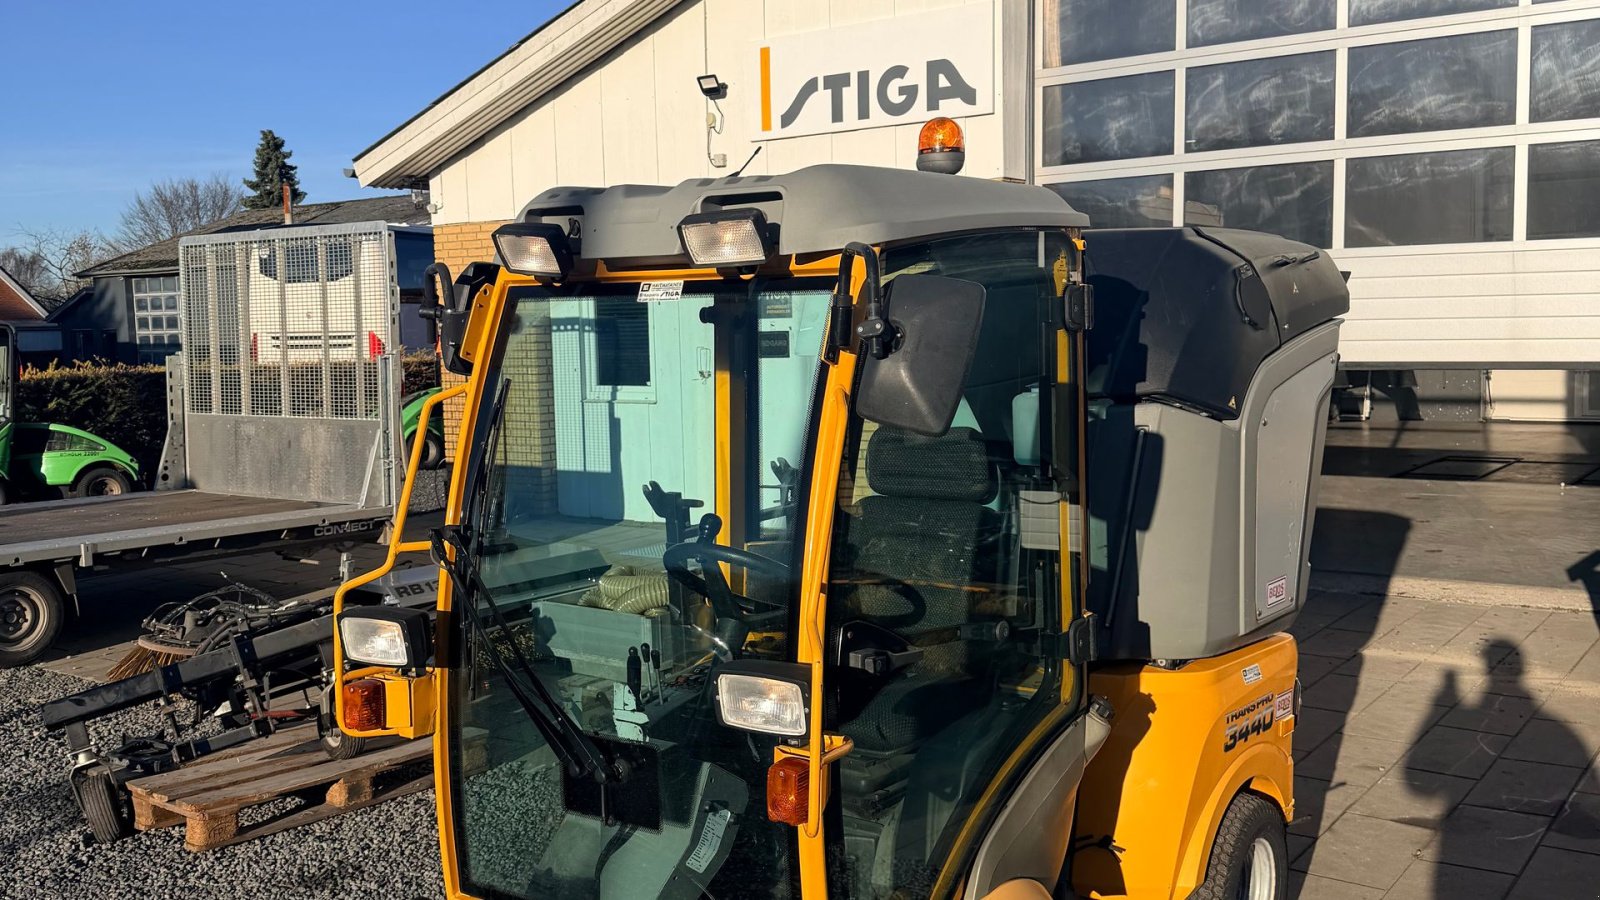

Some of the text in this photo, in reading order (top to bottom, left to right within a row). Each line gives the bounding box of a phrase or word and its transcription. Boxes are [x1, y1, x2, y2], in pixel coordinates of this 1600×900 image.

[781, 58, 977, 129] STIGA
[314, 520, 376, 537] CONNECT
[394, 583, 425, 598] RB
[1223, 705, 1274, 753] 3440
